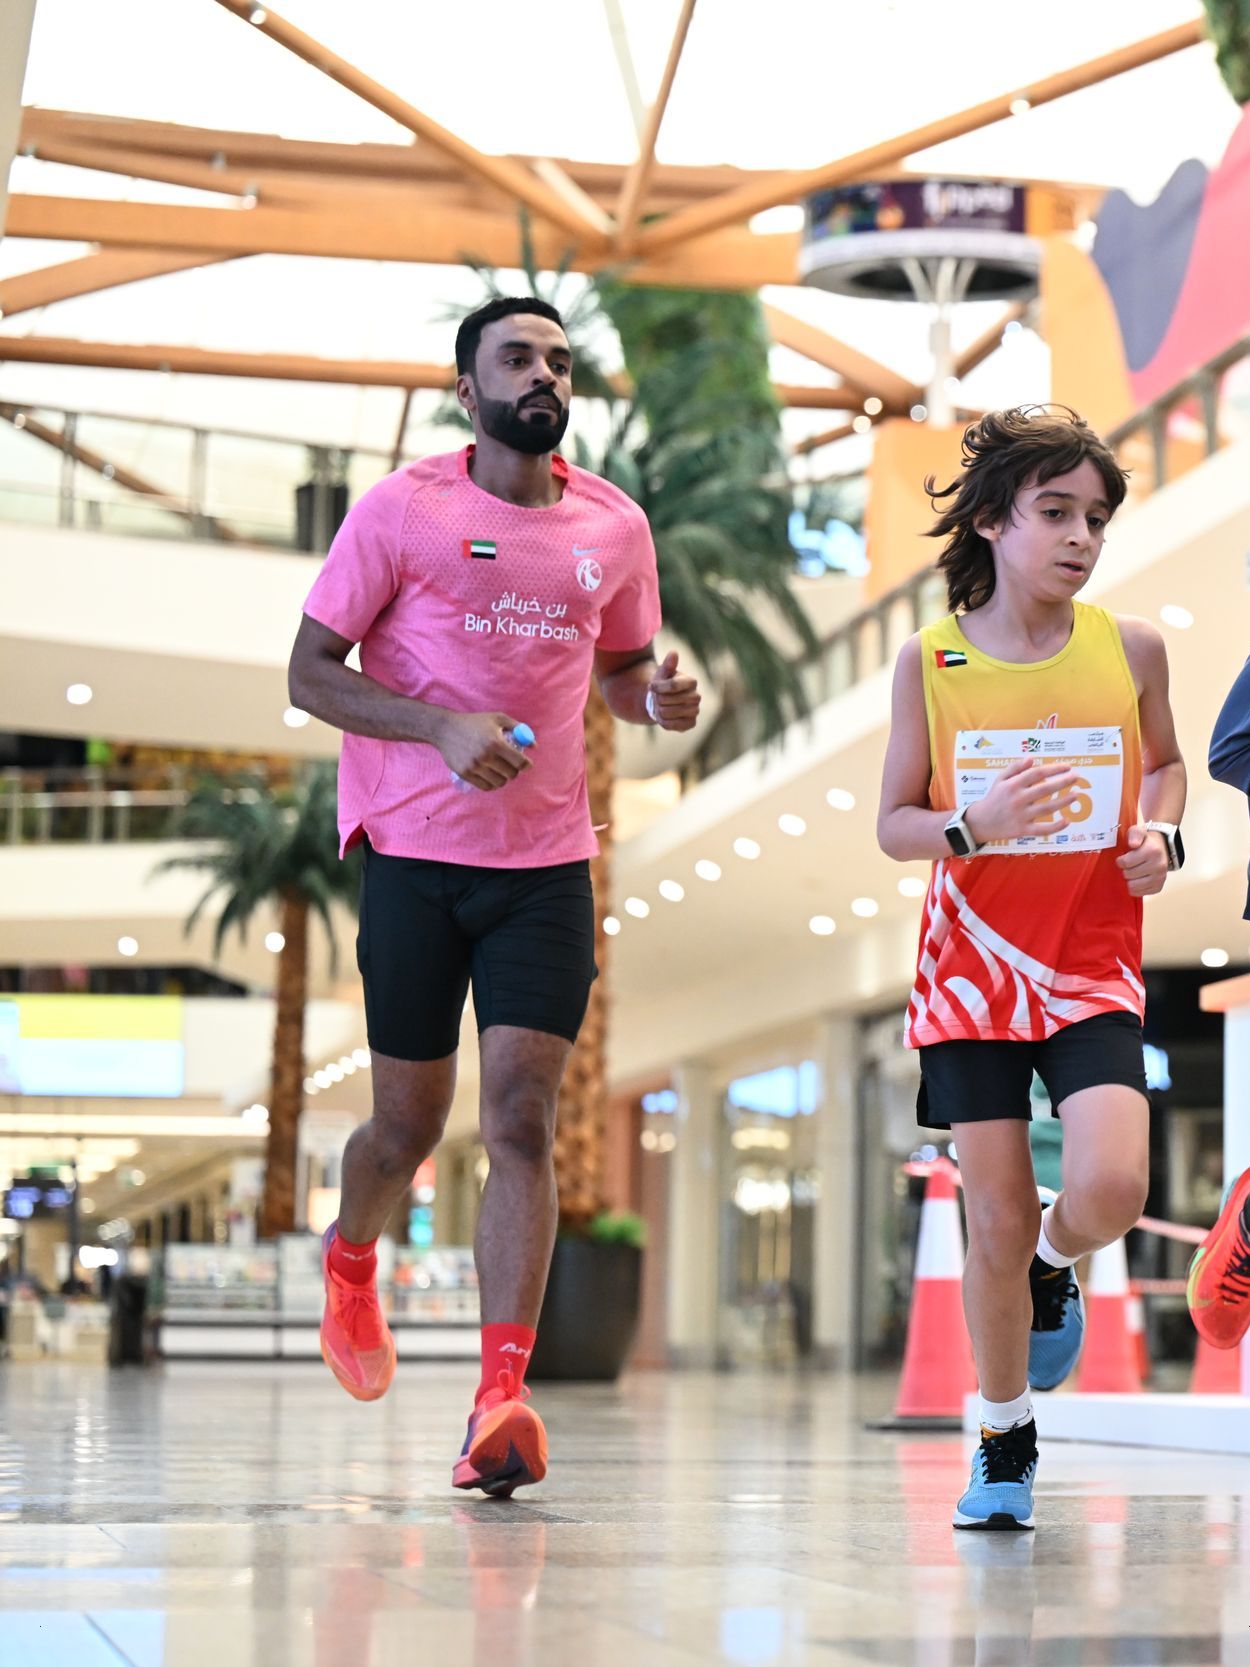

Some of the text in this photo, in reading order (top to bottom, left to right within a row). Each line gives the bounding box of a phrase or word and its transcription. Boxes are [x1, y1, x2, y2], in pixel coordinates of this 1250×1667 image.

[491, 592, 568, 618] بن خرباش
[464, 614, 579, 641] Bin Kharbash
